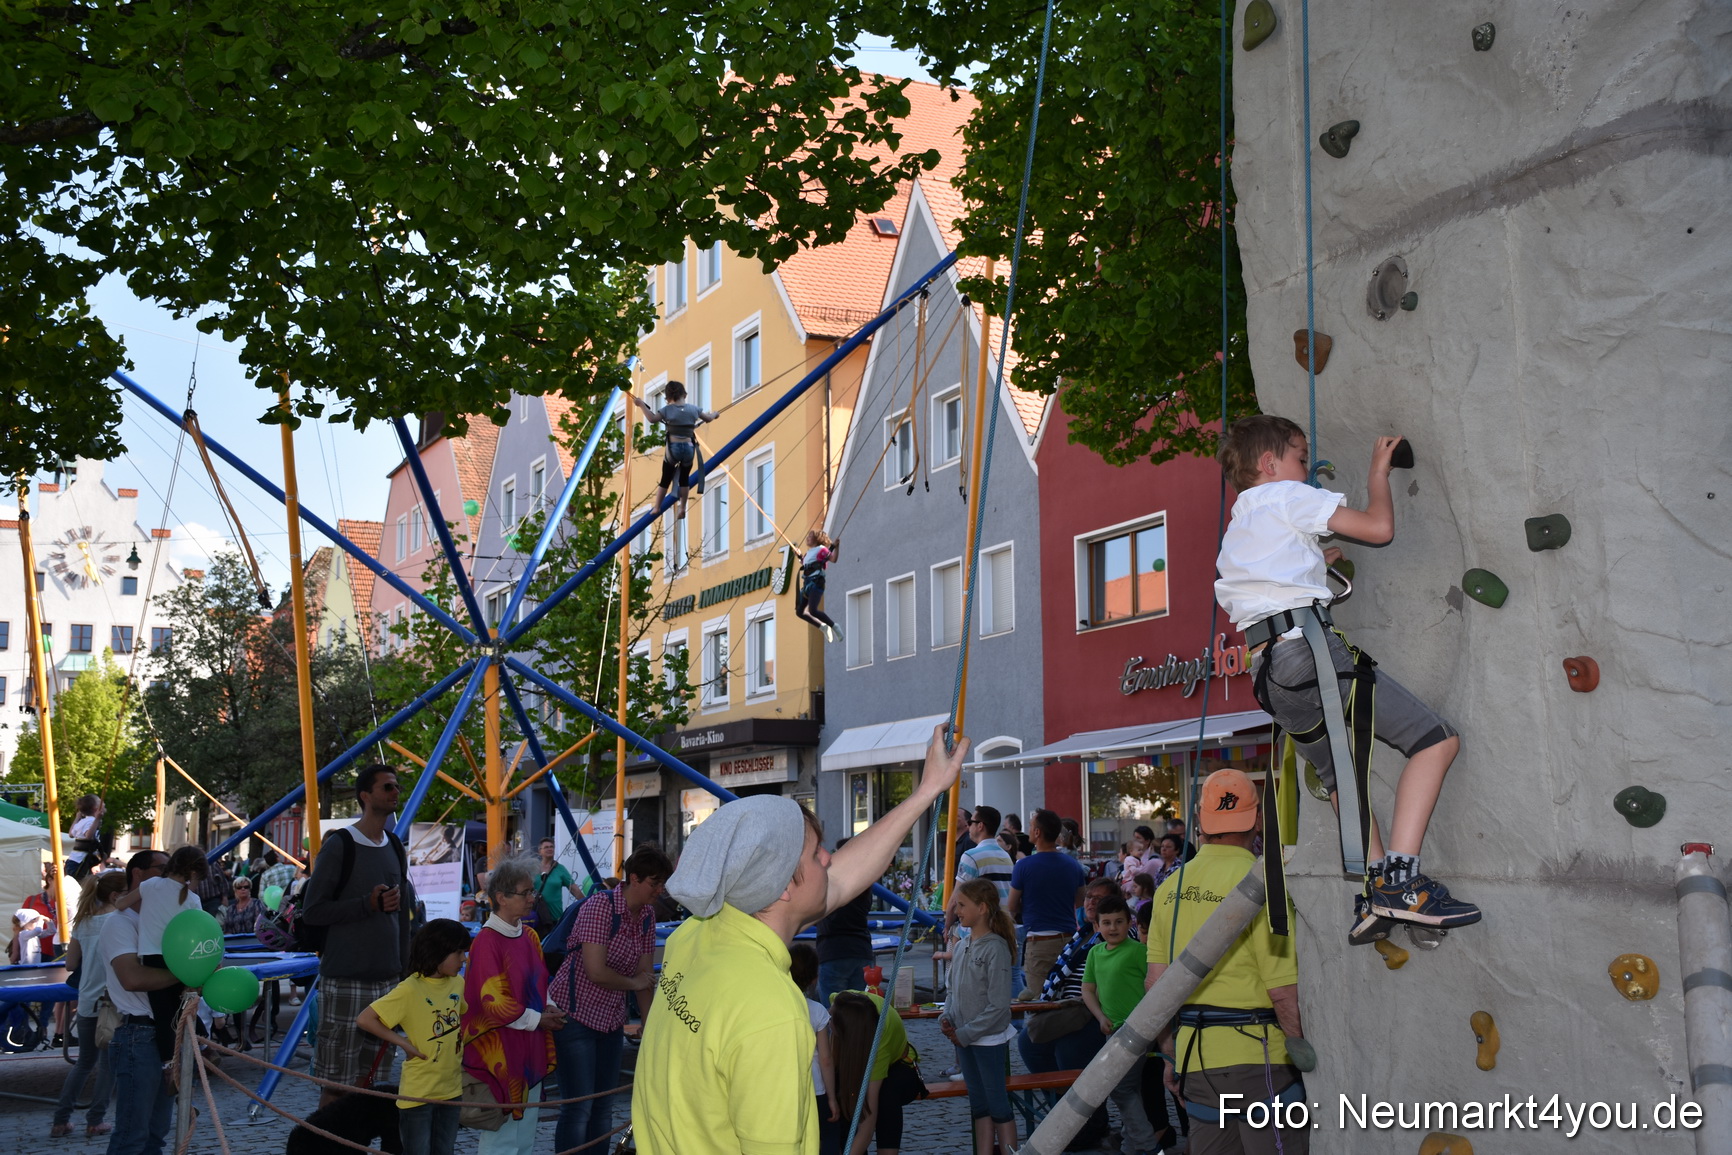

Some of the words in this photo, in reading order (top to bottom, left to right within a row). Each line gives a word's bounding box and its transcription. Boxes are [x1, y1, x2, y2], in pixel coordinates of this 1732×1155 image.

[698, 566, 772, 609] IMMOBILIEN
[680, 730, 725, 748] Bavaria-Kino
[720, 762, 732, 775] KINO
[190, 936, 221, 956] AOK
